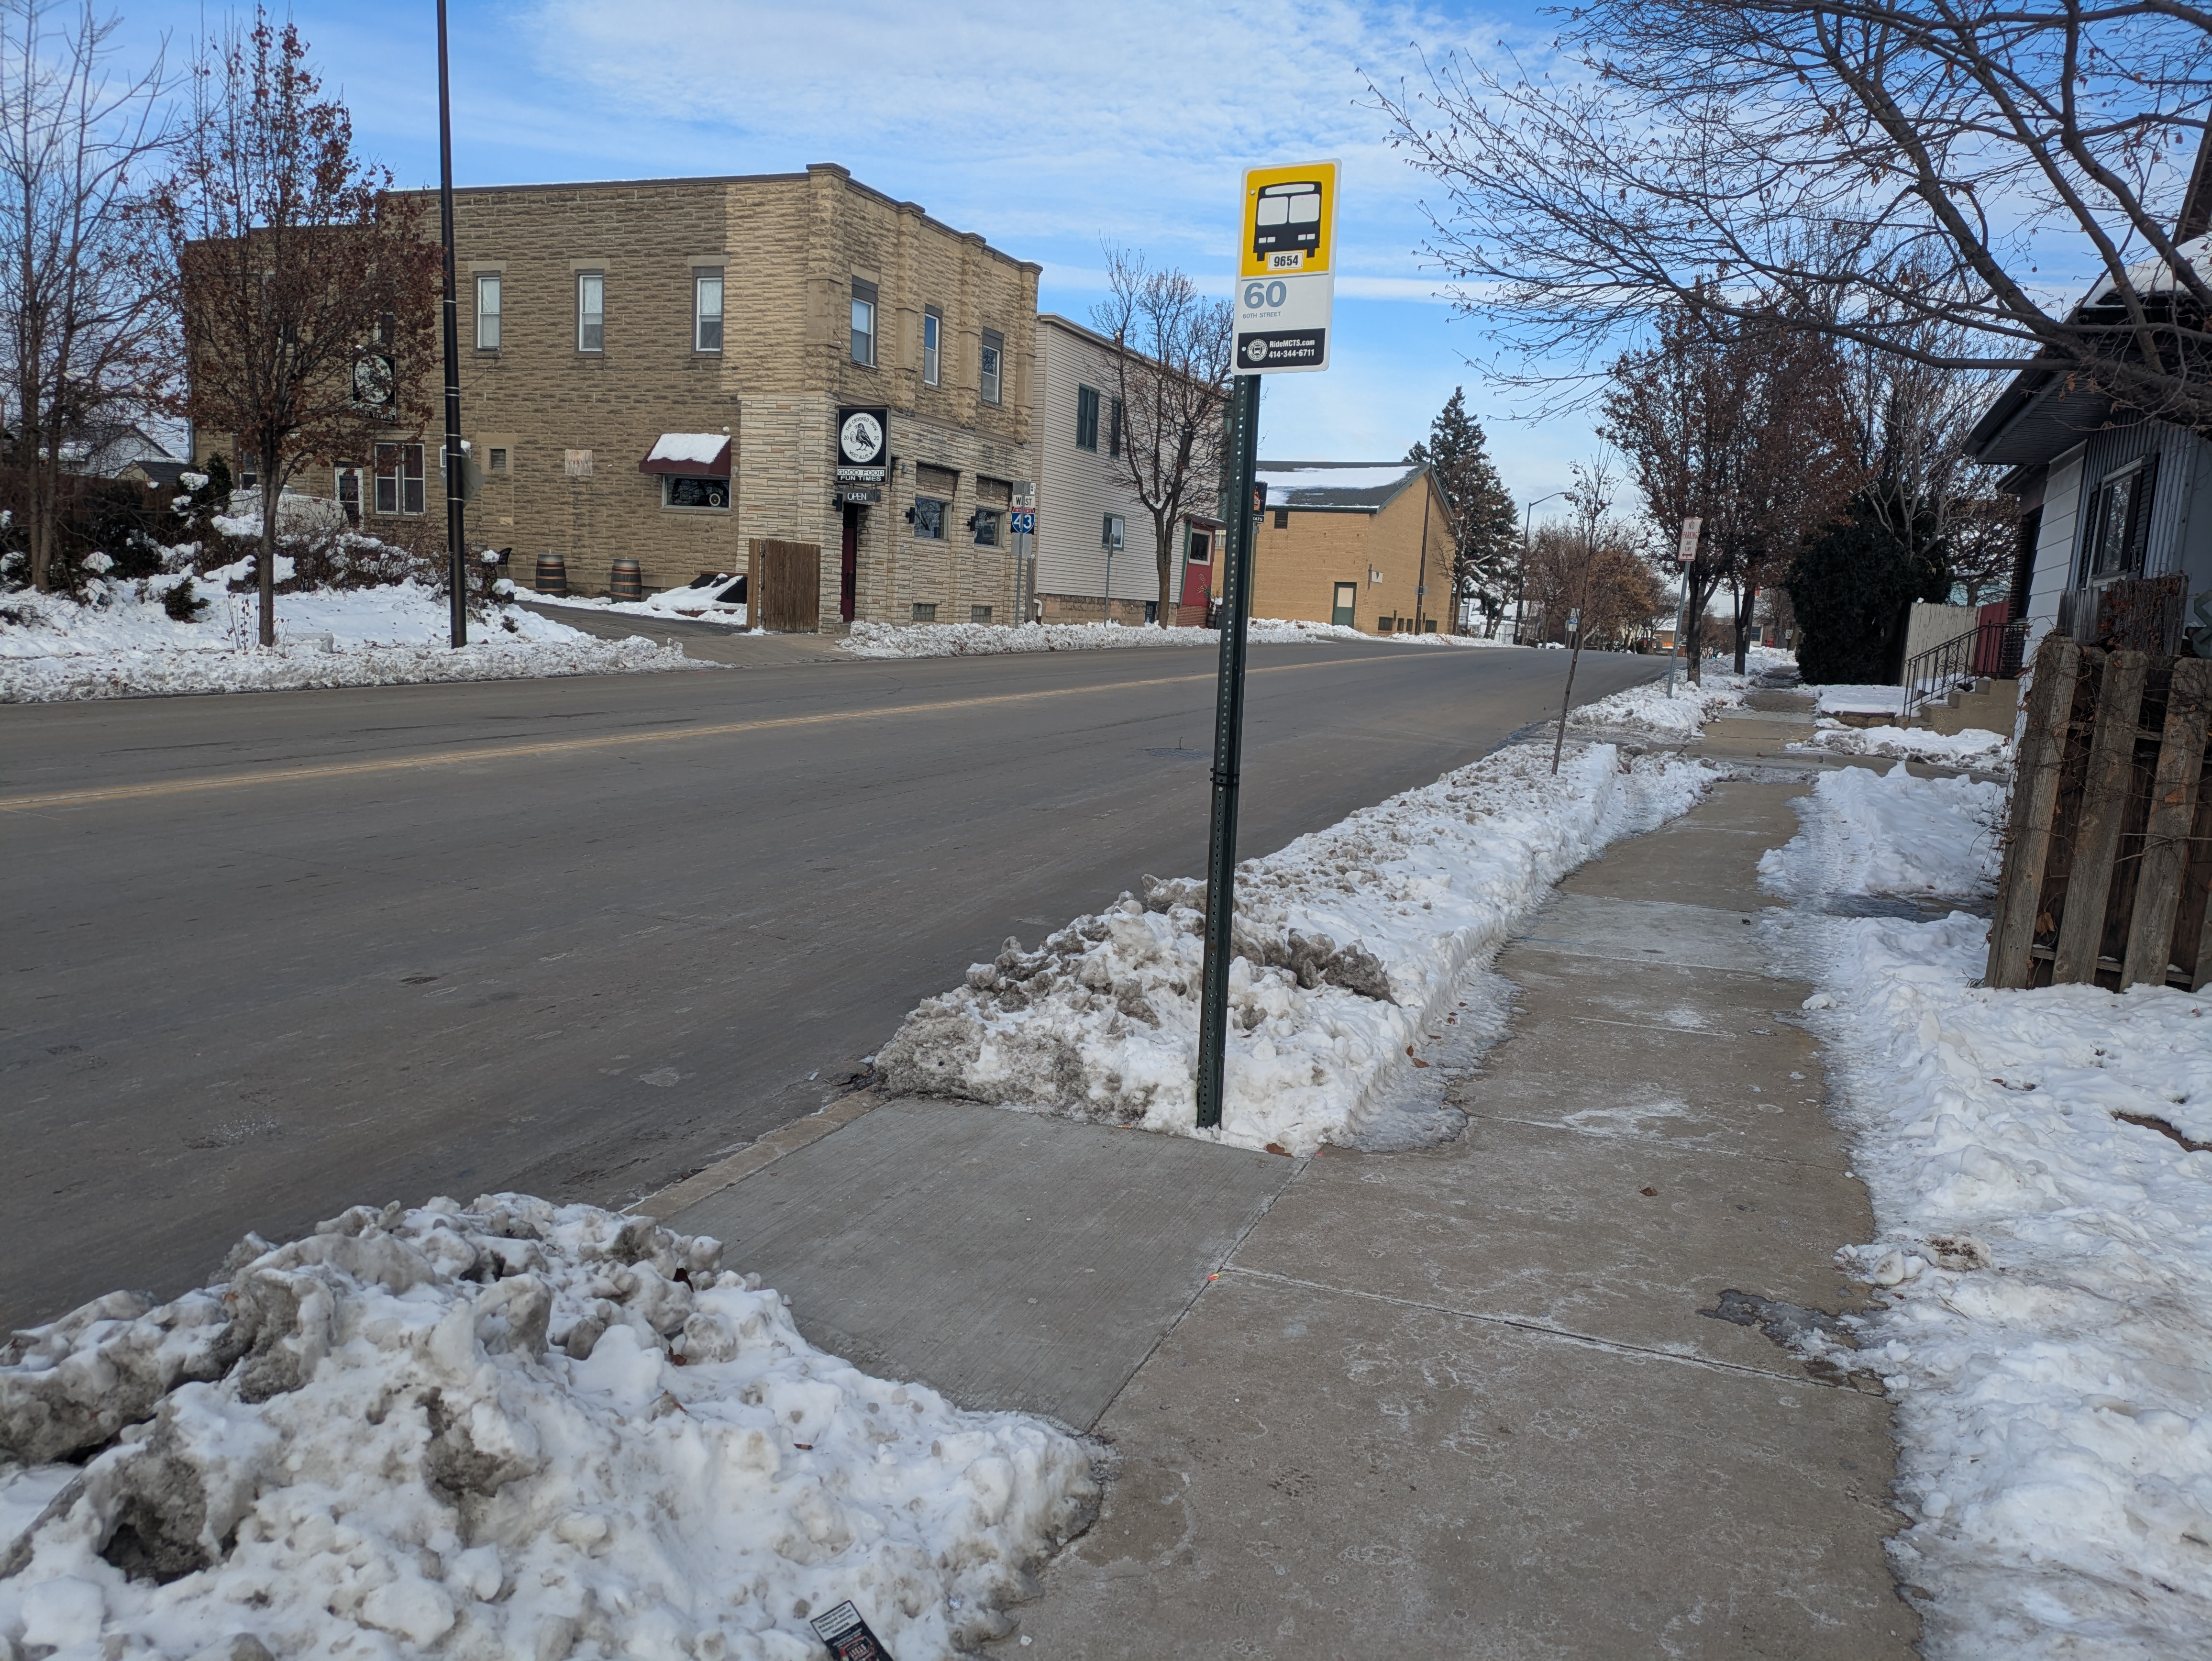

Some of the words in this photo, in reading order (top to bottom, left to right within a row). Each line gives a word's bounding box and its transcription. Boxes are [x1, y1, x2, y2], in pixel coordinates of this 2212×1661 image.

[1274, 255, 1298, 267] 9654
[1244, 281, 1287, 309] 60
[1269, 339, 1315, 348] RideMCTS.com
[1269, 349, 1315, 358] 414-344-6711
[869, 421, 878, 431] CROW
[849, 450, 859, 458] WEST
[847, 492, 866, 500] OPEN
[1016, 497, 1032, 506] WST
[1013, 514, 1032, 529] 43
[1688, 521, 1695, 530] NO
